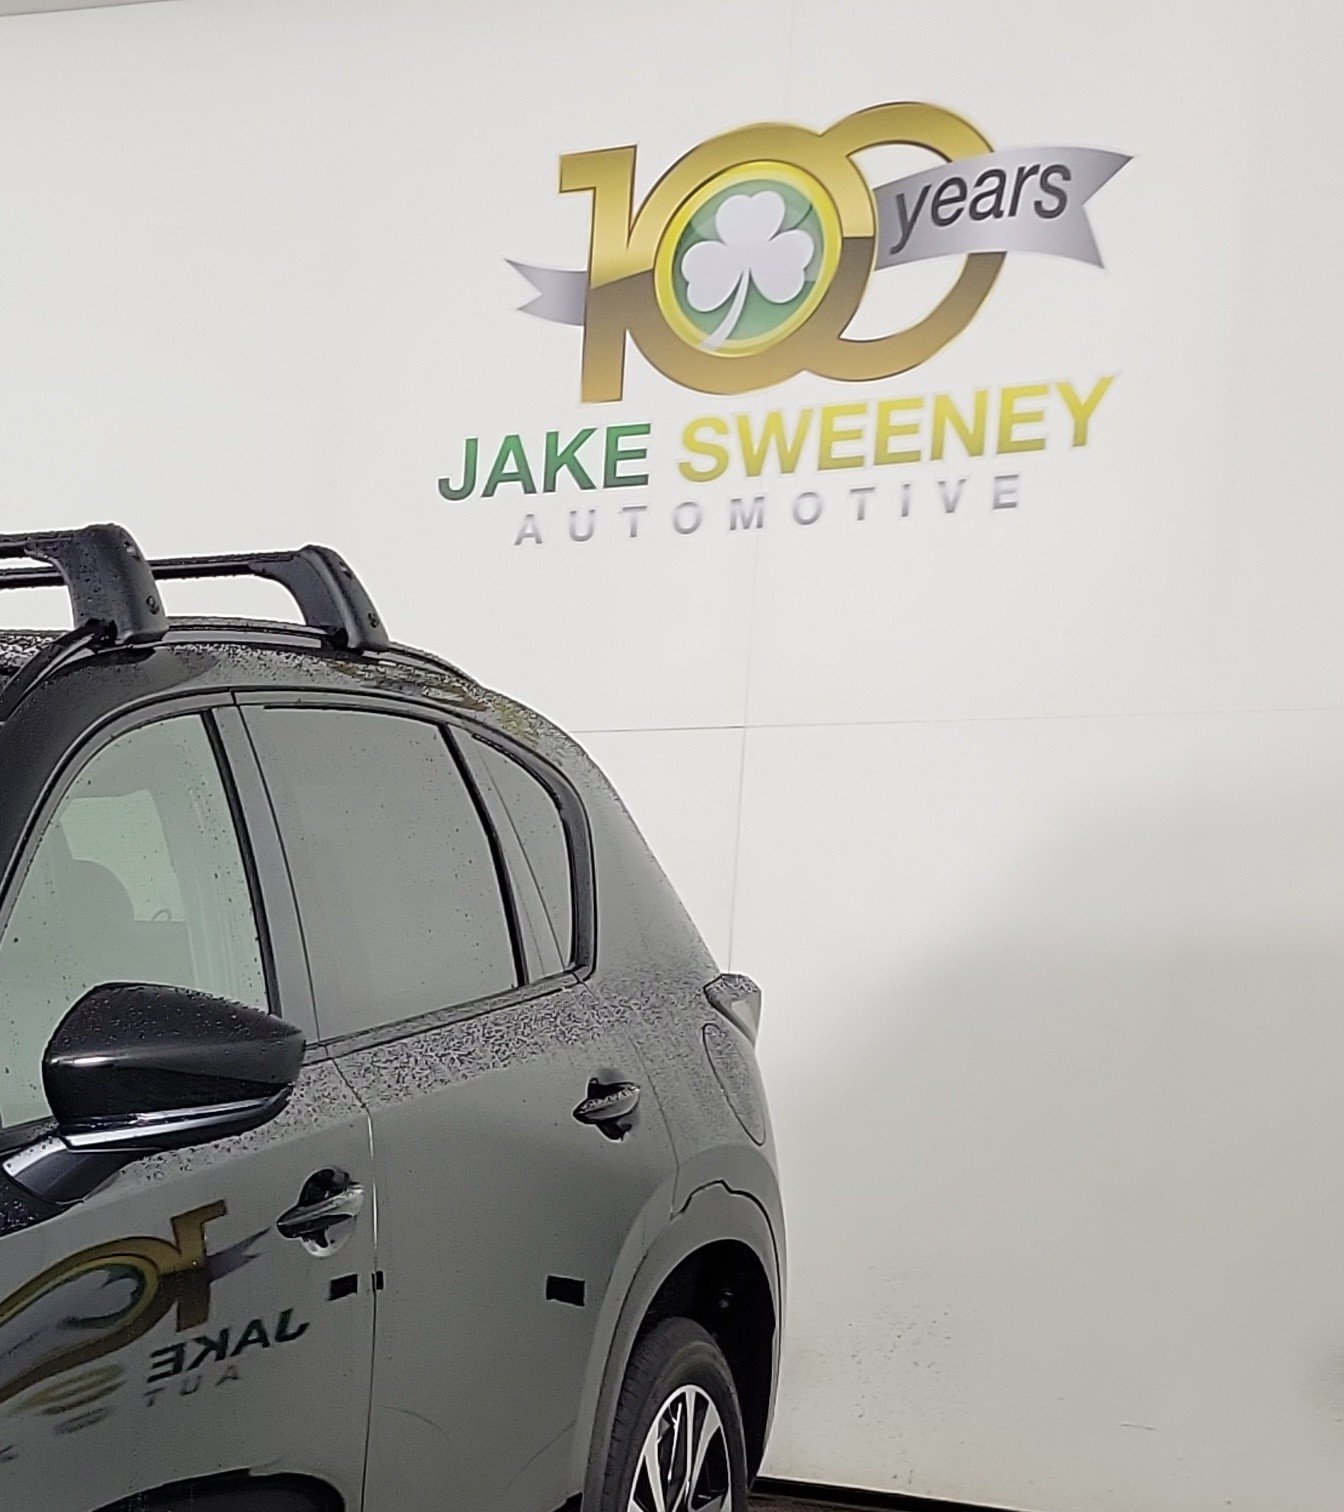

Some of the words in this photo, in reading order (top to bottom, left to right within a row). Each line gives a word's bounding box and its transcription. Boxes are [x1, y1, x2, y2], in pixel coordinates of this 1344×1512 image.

[559, 101, 1008, 404] 100
[889, 159, 1072, 256] years
[437, 422, 652, 502] JAKE
[678, 375, 1116, 484] SWEENEY
[514, 474, 1021, 547] AUTOMOTIVE
